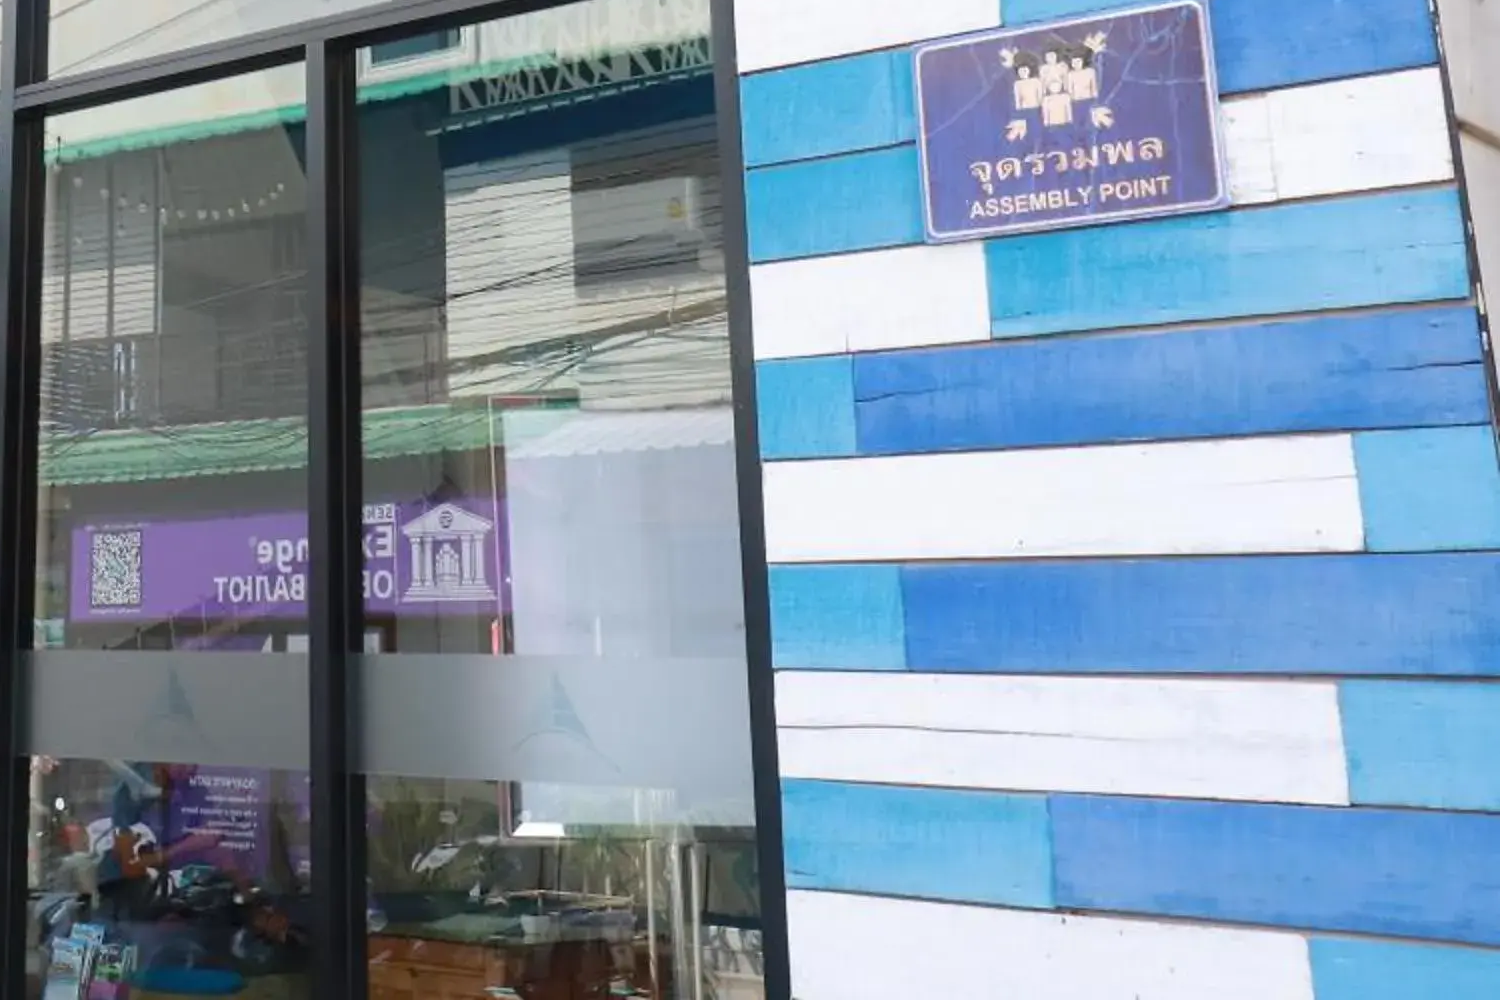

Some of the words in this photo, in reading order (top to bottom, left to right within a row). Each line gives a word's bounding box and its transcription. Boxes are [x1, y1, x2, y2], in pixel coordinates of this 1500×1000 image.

[969, 136, 1164, 195] จุดรวมพล
[969, 186, 1093, 219] ASSEMBLY
[1099, 176, 1171, 203] POINT
